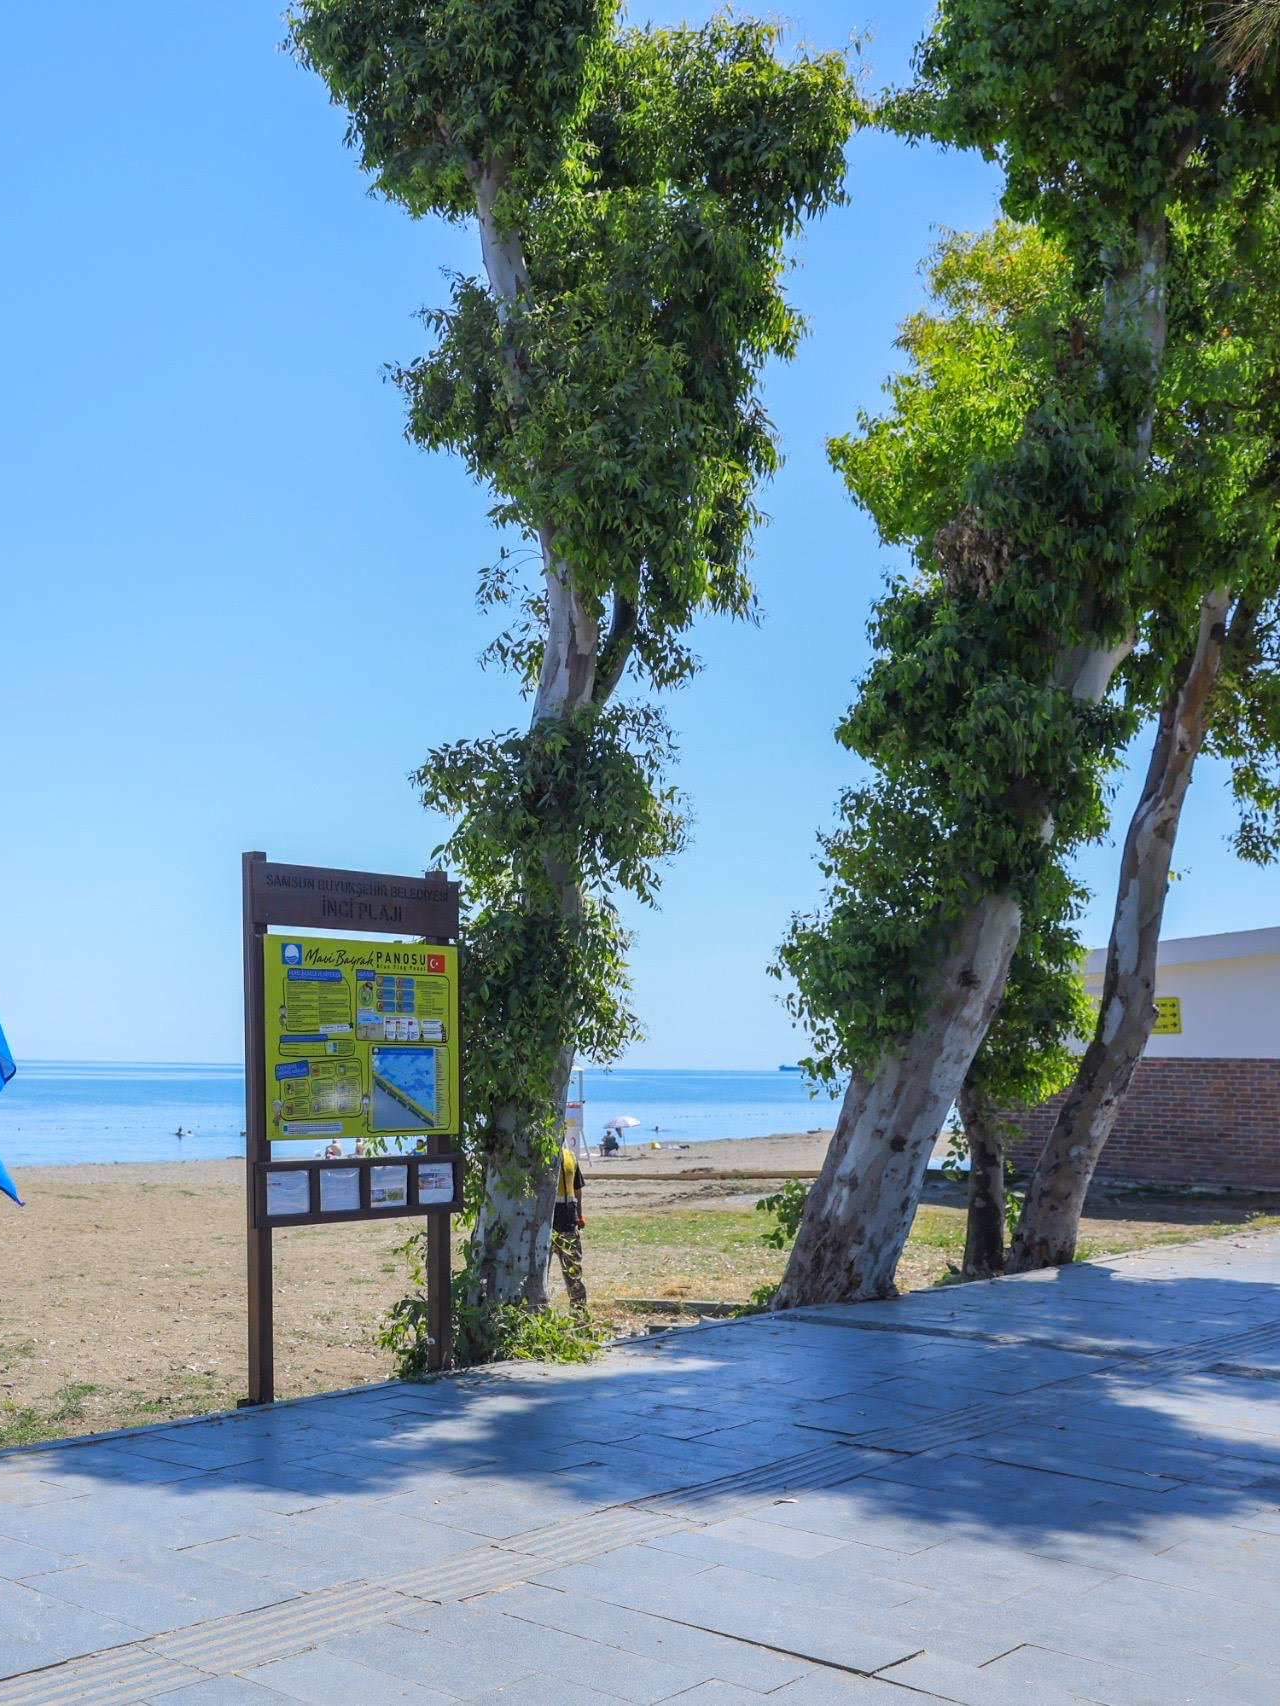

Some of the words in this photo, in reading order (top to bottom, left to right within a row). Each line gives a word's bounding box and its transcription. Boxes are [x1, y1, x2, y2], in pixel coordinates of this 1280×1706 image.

[266, 874, 316, 890] SAMSUN
[318, 878, 387, 898] BÜYÜKŞEHİR
[390, 884, 449, 903] BELEDİYESİ
[322, 895, 354, 918] İNCİ
[359, 902, 402, 923] PLAJI
[304, 947, 334, 965] Mavi
[334, 950, 374, 972] Bayrak
[376, 951, 426, 965] PANOSU
